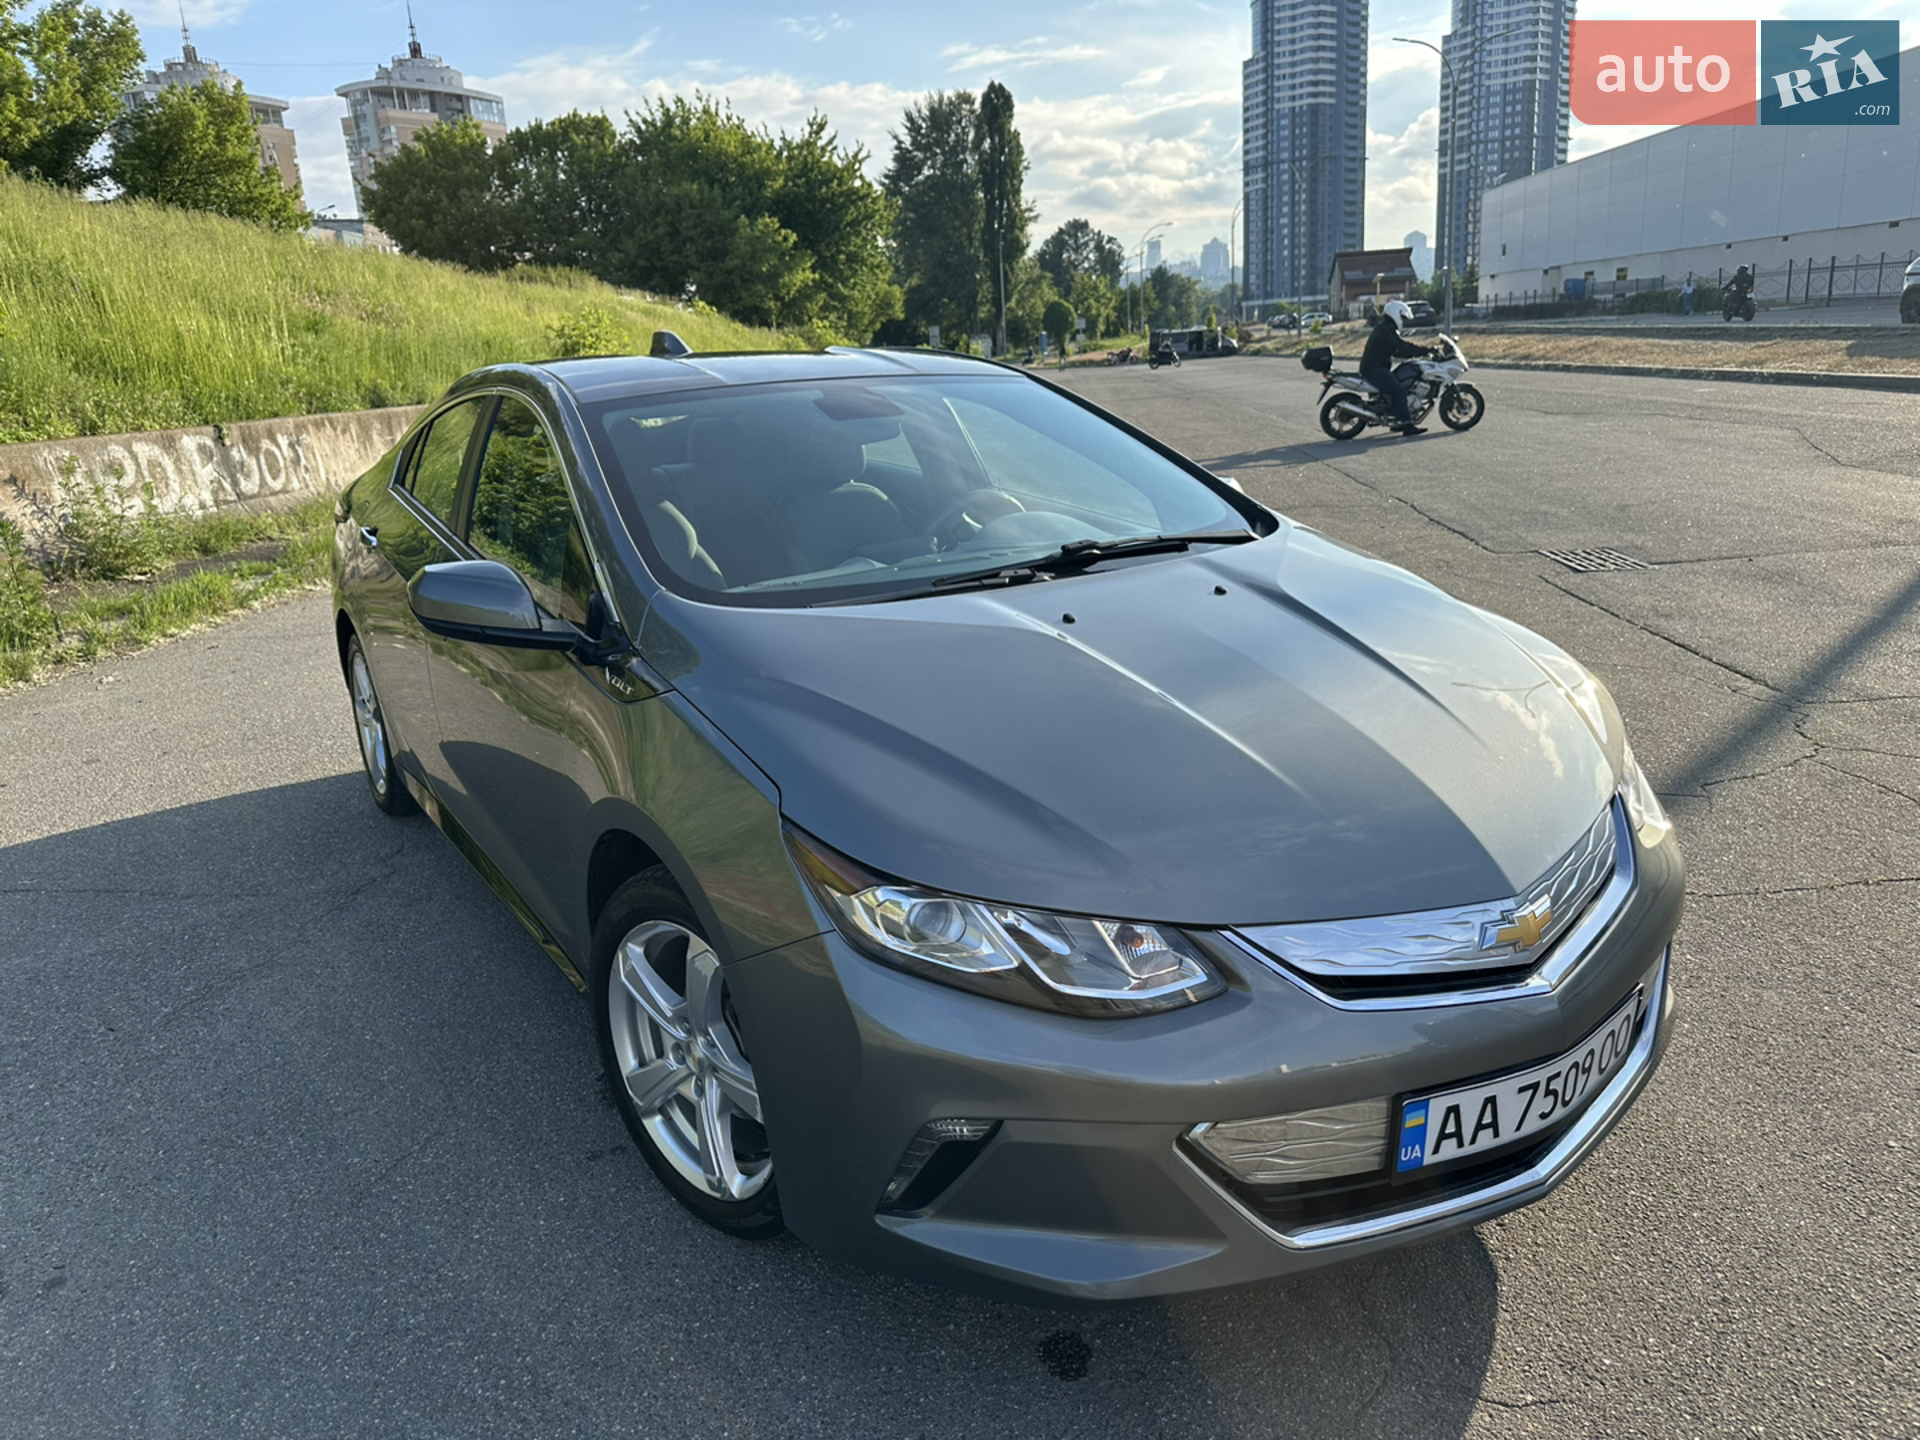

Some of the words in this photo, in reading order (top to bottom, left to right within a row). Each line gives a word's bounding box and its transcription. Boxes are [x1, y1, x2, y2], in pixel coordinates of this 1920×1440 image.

[1431, 1095, 1500, 1155] AA
[1514, 1048, 1595, 1132] 7509
[1400, 1145, 1422, 1161] UA
